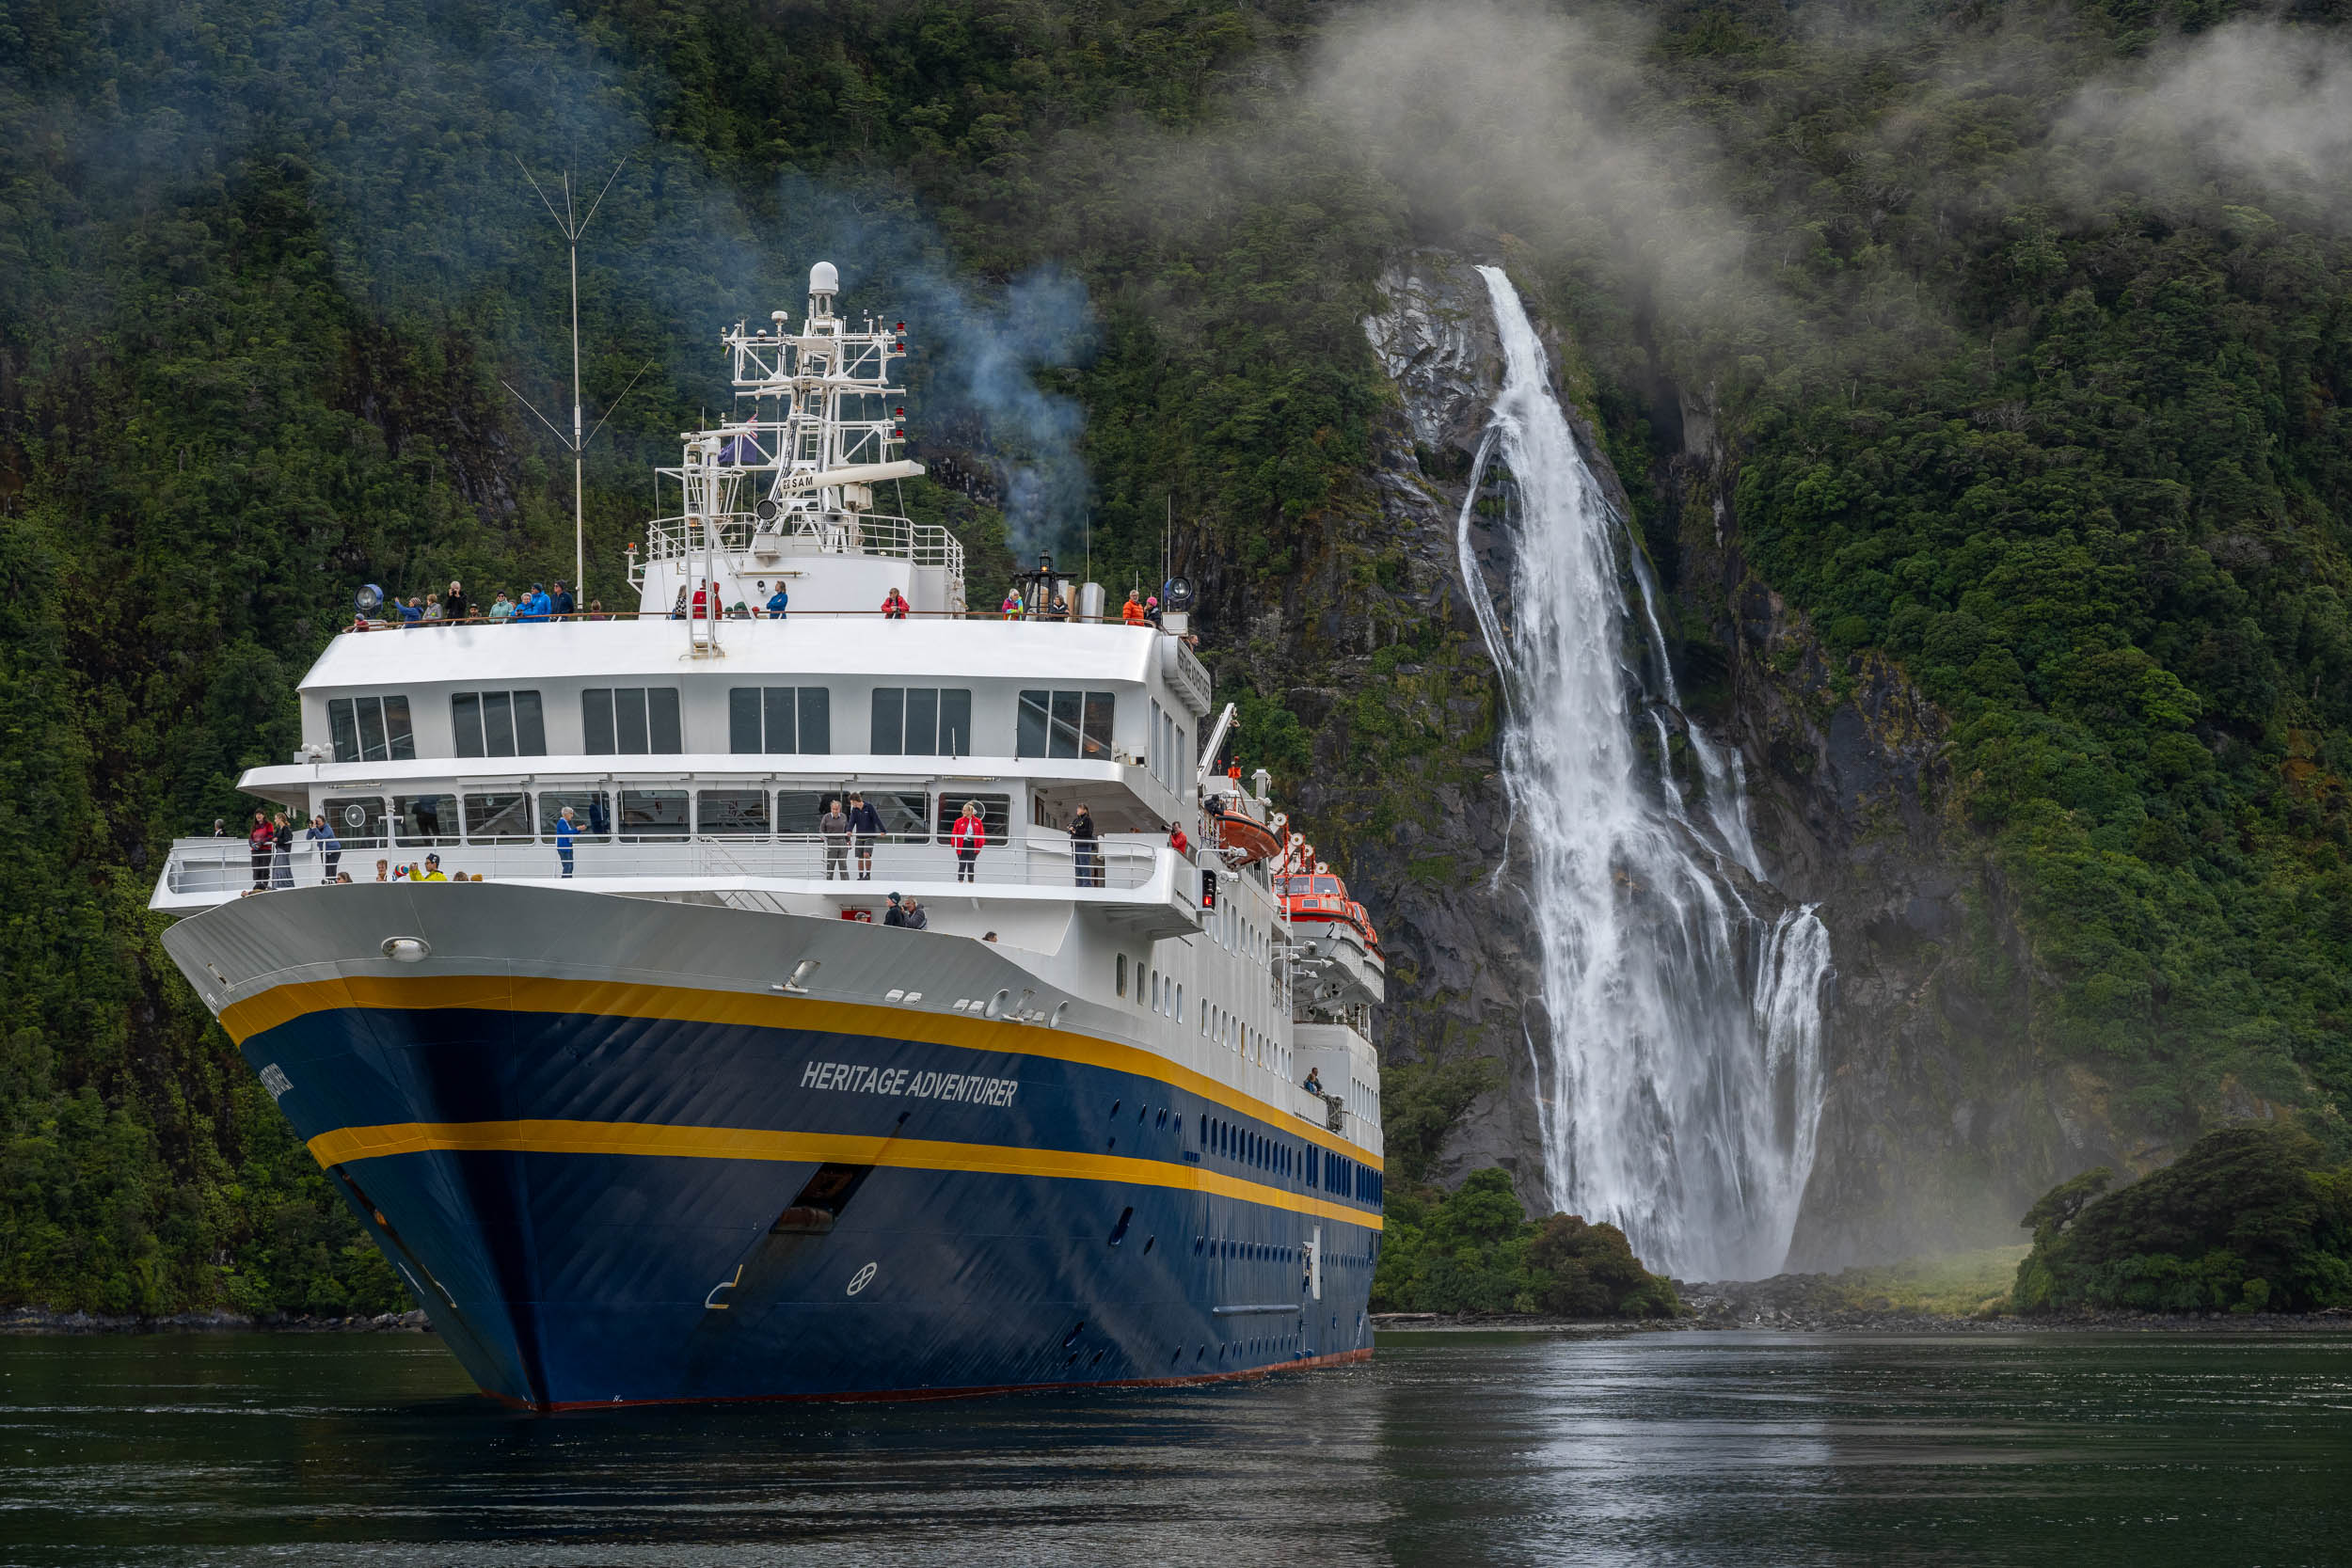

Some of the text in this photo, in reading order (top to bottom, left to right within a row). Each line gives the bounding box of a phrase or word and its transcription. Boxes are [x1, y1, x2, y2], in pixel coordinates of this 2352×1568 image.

[792, 476, 813, 487] SAM
[1326, 922, 1335, 939] 2
[800, 1061, 1018, 1107] HERITAGE ADVENTURER
